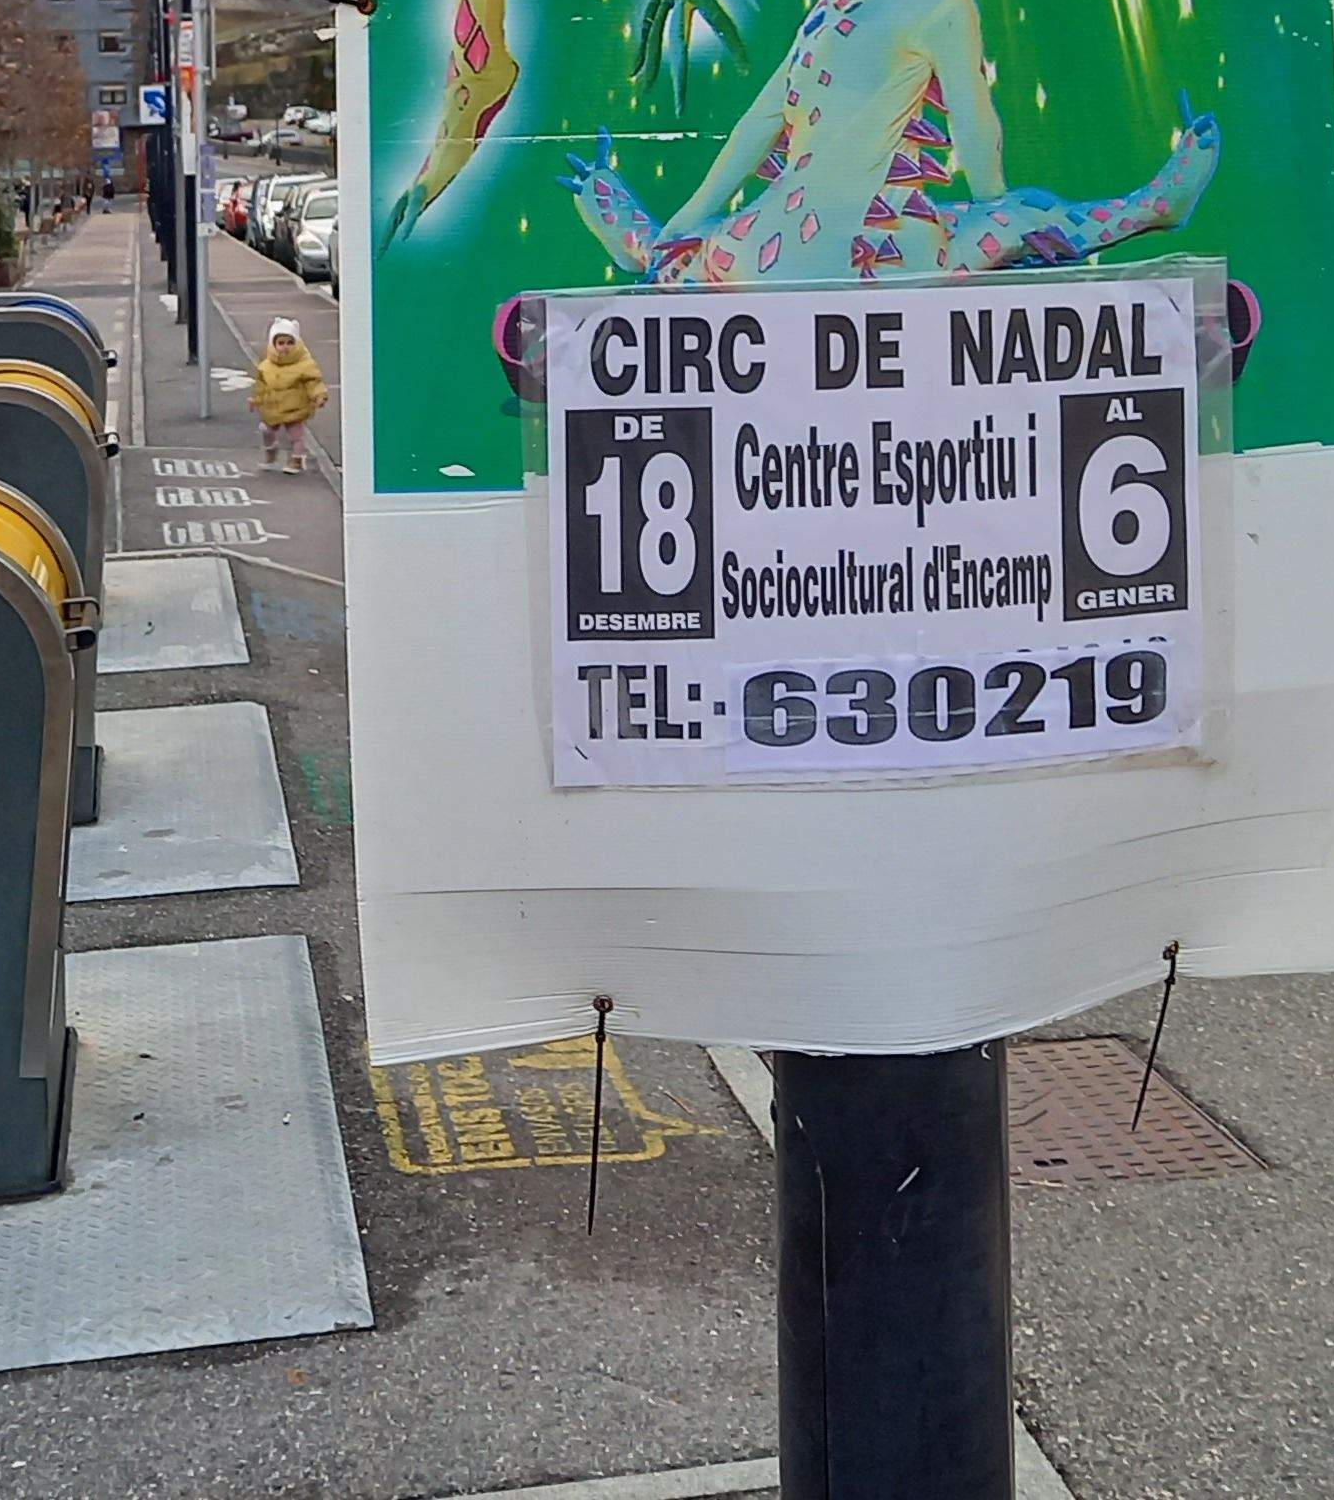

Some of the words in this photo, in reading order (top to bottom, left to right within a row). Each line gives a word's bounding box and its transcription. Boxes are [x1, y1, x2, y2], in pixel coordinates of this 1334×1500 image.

[590, 313, 767, 397] CIRC
[814, 311, 905, 391] DE
[949, 302, 1162, 387] NADAL
[613, 414, 666, 441] DE
[1105, 397, 1143, 423] AL
[734, 422, 860, 512] Centre
[871, 414, 1017, 529] Esportiu
[1027, 411, 1037, 498] i
[1078, 432, 1173, 577] 6
[584, 451, 697, 597] 18
[578, 611, 702, 632] DESEMBRE
[721, 545, 915, 620] Sociocultural
[922, 543, 1053, 623] d'Encamp
[1075, 582, 1176, 612] GENER
[742, 649, 1168, 748] 630219
